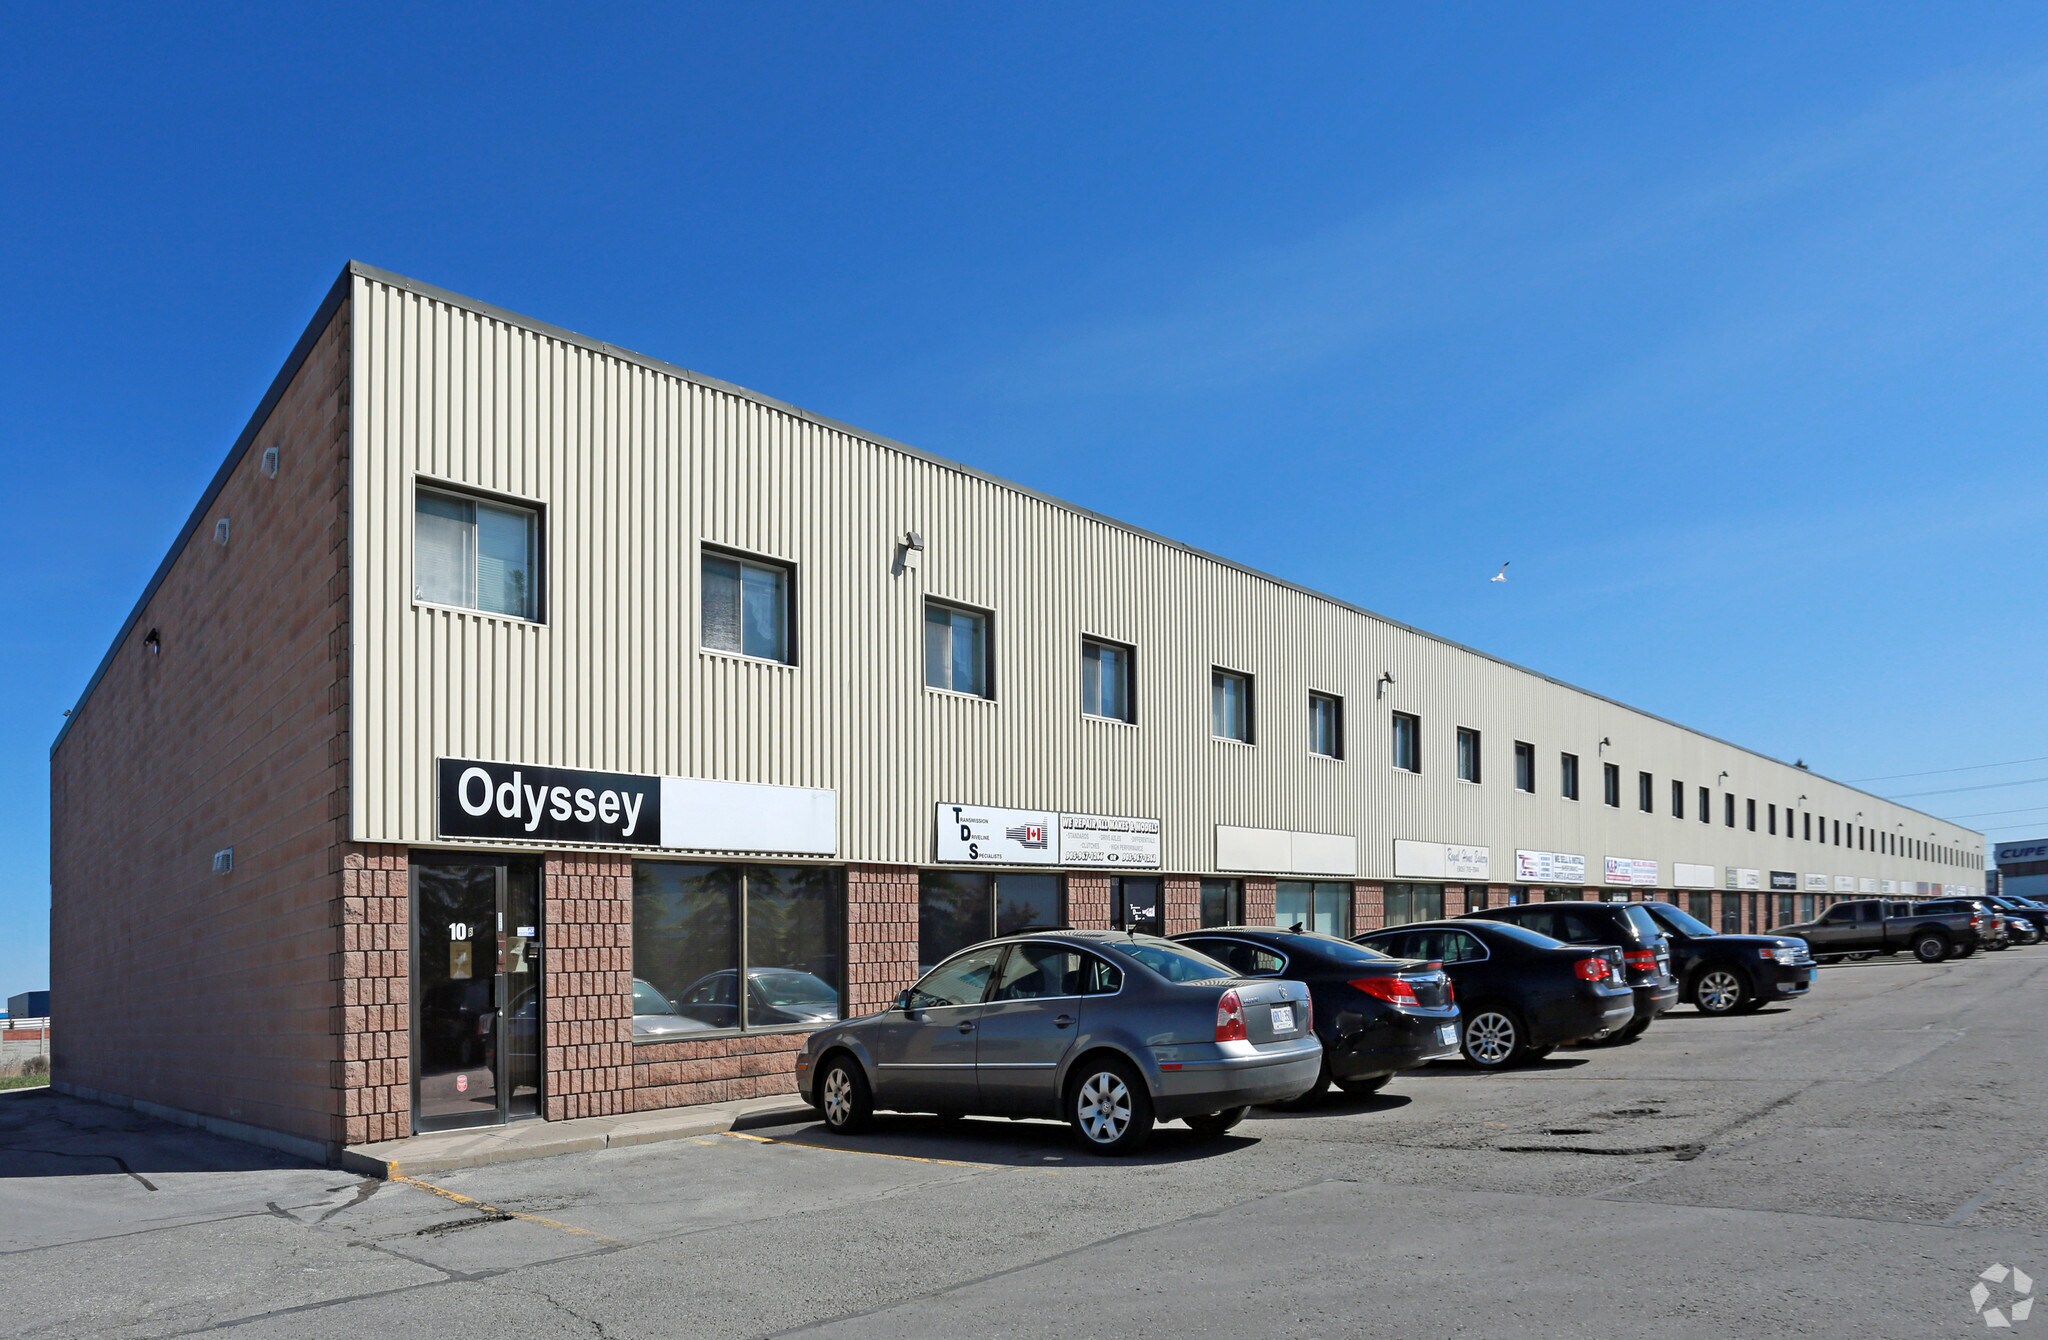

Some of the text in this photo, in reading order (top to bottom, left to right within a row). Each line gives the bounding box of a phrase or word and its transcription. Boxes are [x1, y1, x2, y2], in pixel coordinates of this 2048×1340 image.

[458, 767, 644, 837] Odyssey
[952, 807, 989, 824] TRANSMISSION
[960, 824, 990, 841] DRIVELINE
[1062, 817, 1073, 829] WE
[1074, 817, 1097, 831] REPAIR
[1098, 818, 1109, 831] ALL
[1109, 819, 1129, 832] MAKES
[1136, 821, 1158, 834] MODELS
[969, 843, 1003, 860] SPECIALISTS
[2001, 846, 2047, 859] CUPE
[448, 922, 467, 941] 10
